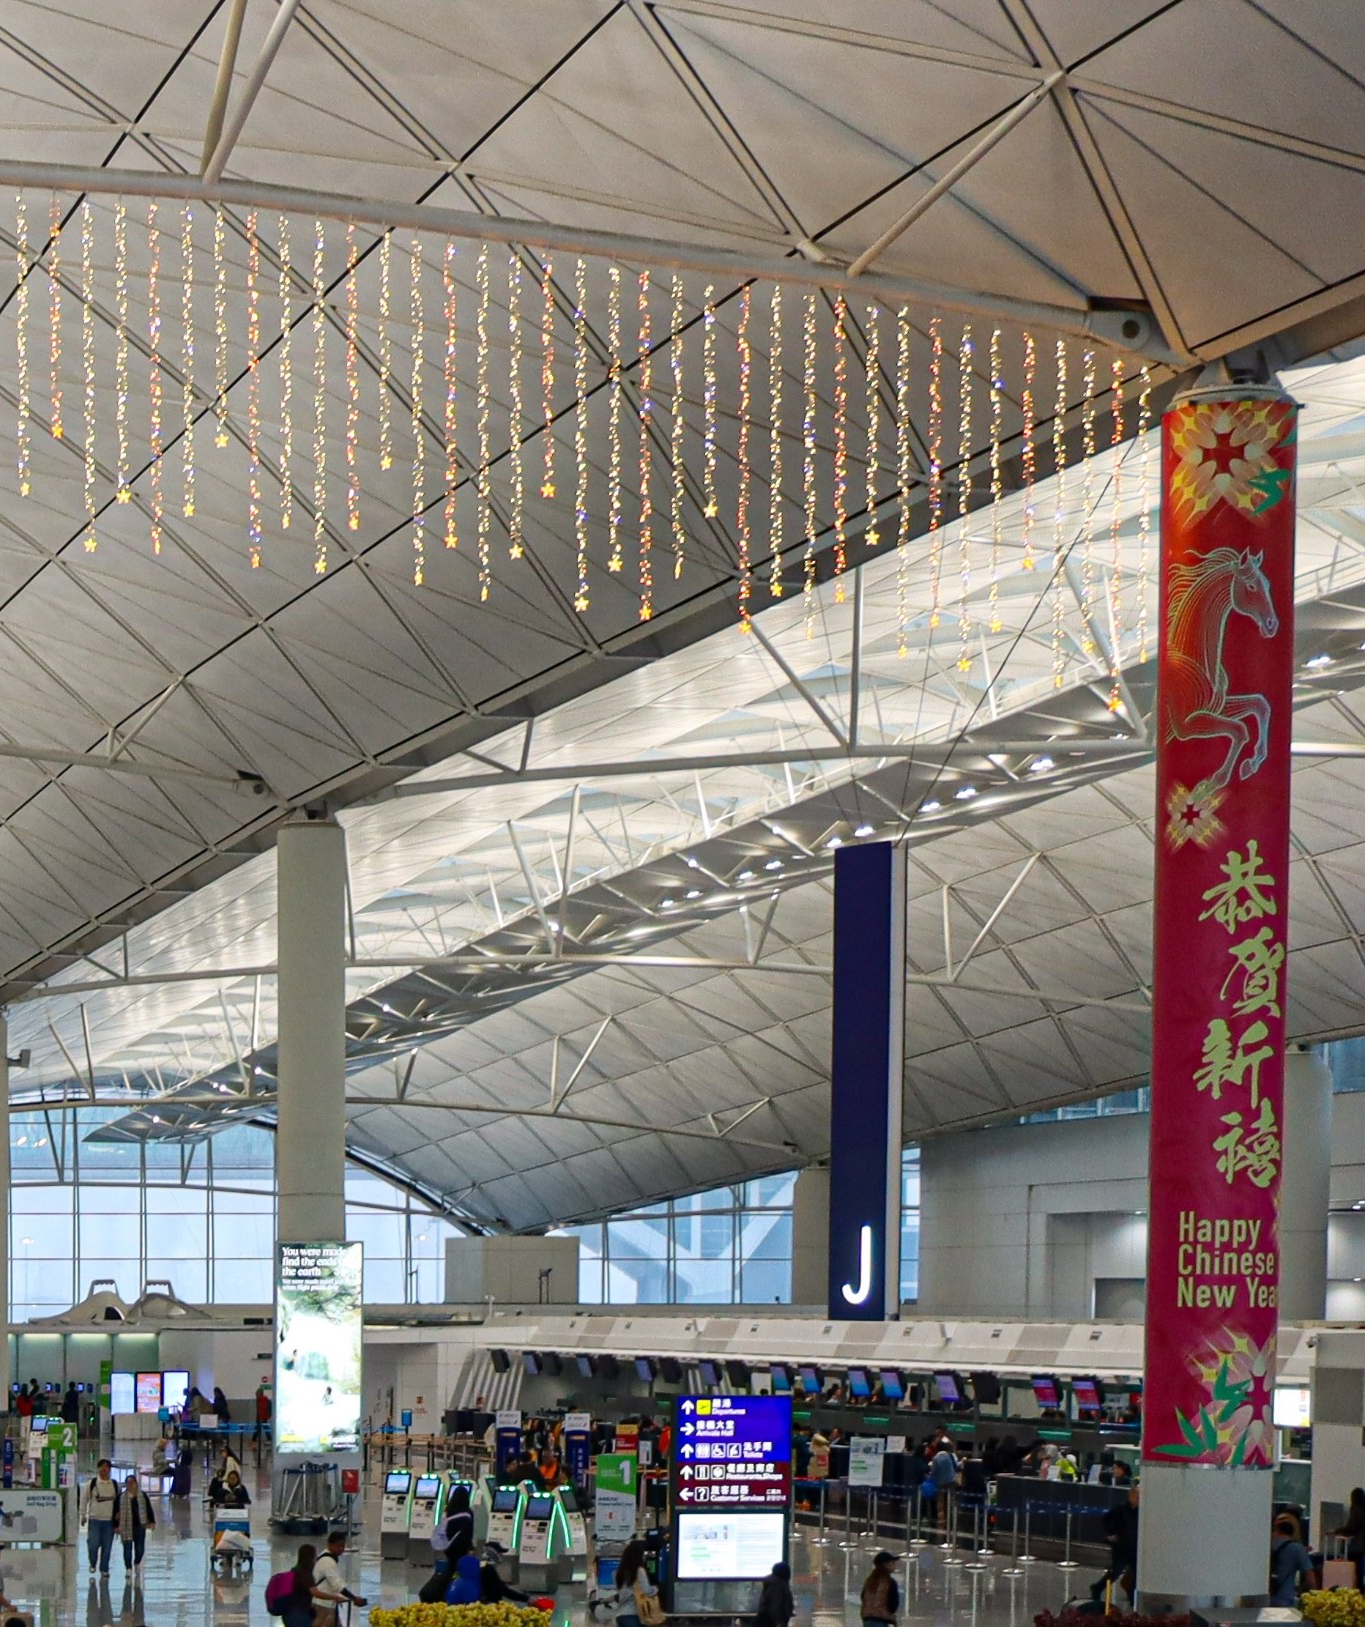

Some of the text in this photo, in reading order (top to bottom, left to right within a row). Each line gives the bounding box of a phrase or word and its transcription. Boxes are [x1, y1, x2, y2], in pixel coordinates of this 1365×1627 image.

[1179, 1210, 1261, 1251] Happy
[282, 1246, 299, 1256] You
[299, 1248, 321, 1256] were
[282, 1256, 300, 1266] find
[300, 1257, 316, 1266] the
[1178, 1243, 1275, 1275] Chinese
[282, 1266, 322, 1276] the earth
[841, 1225, 873, 1305] J
[1177, 1276, 1278, 1308] New Yea
[63, 1427, 73, 1447] 2
[619, 1460, 631, 1485] 1
